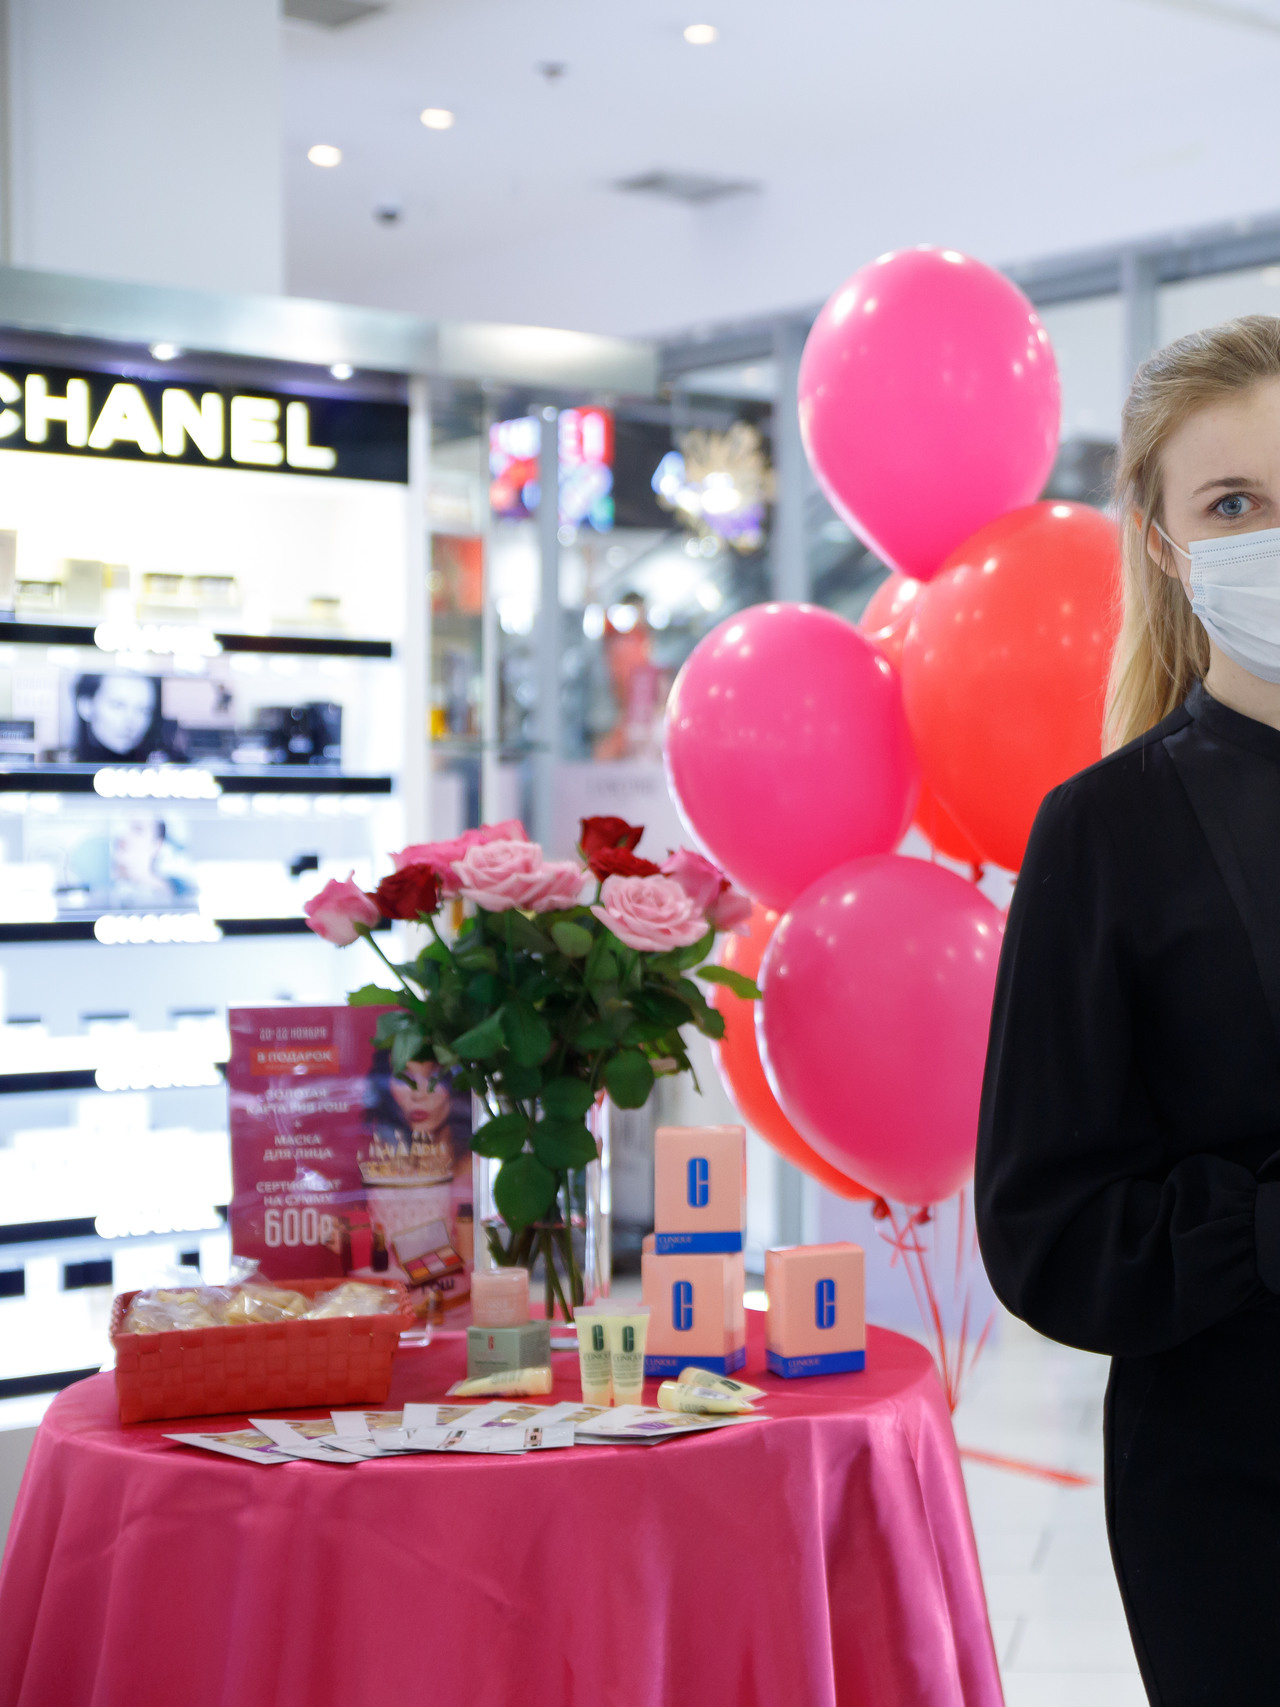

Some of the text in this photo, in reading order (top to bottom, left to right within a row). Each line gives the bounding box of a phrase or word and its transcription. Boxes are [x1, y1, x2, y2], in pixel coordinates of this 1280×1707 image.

[257, 1050, 333, 1064] В ПОДАРОК
[274, 1134, 321, 1147] МАСКА
[263, 1148, 333, 1162] ДЛЯ ЛИЦА
